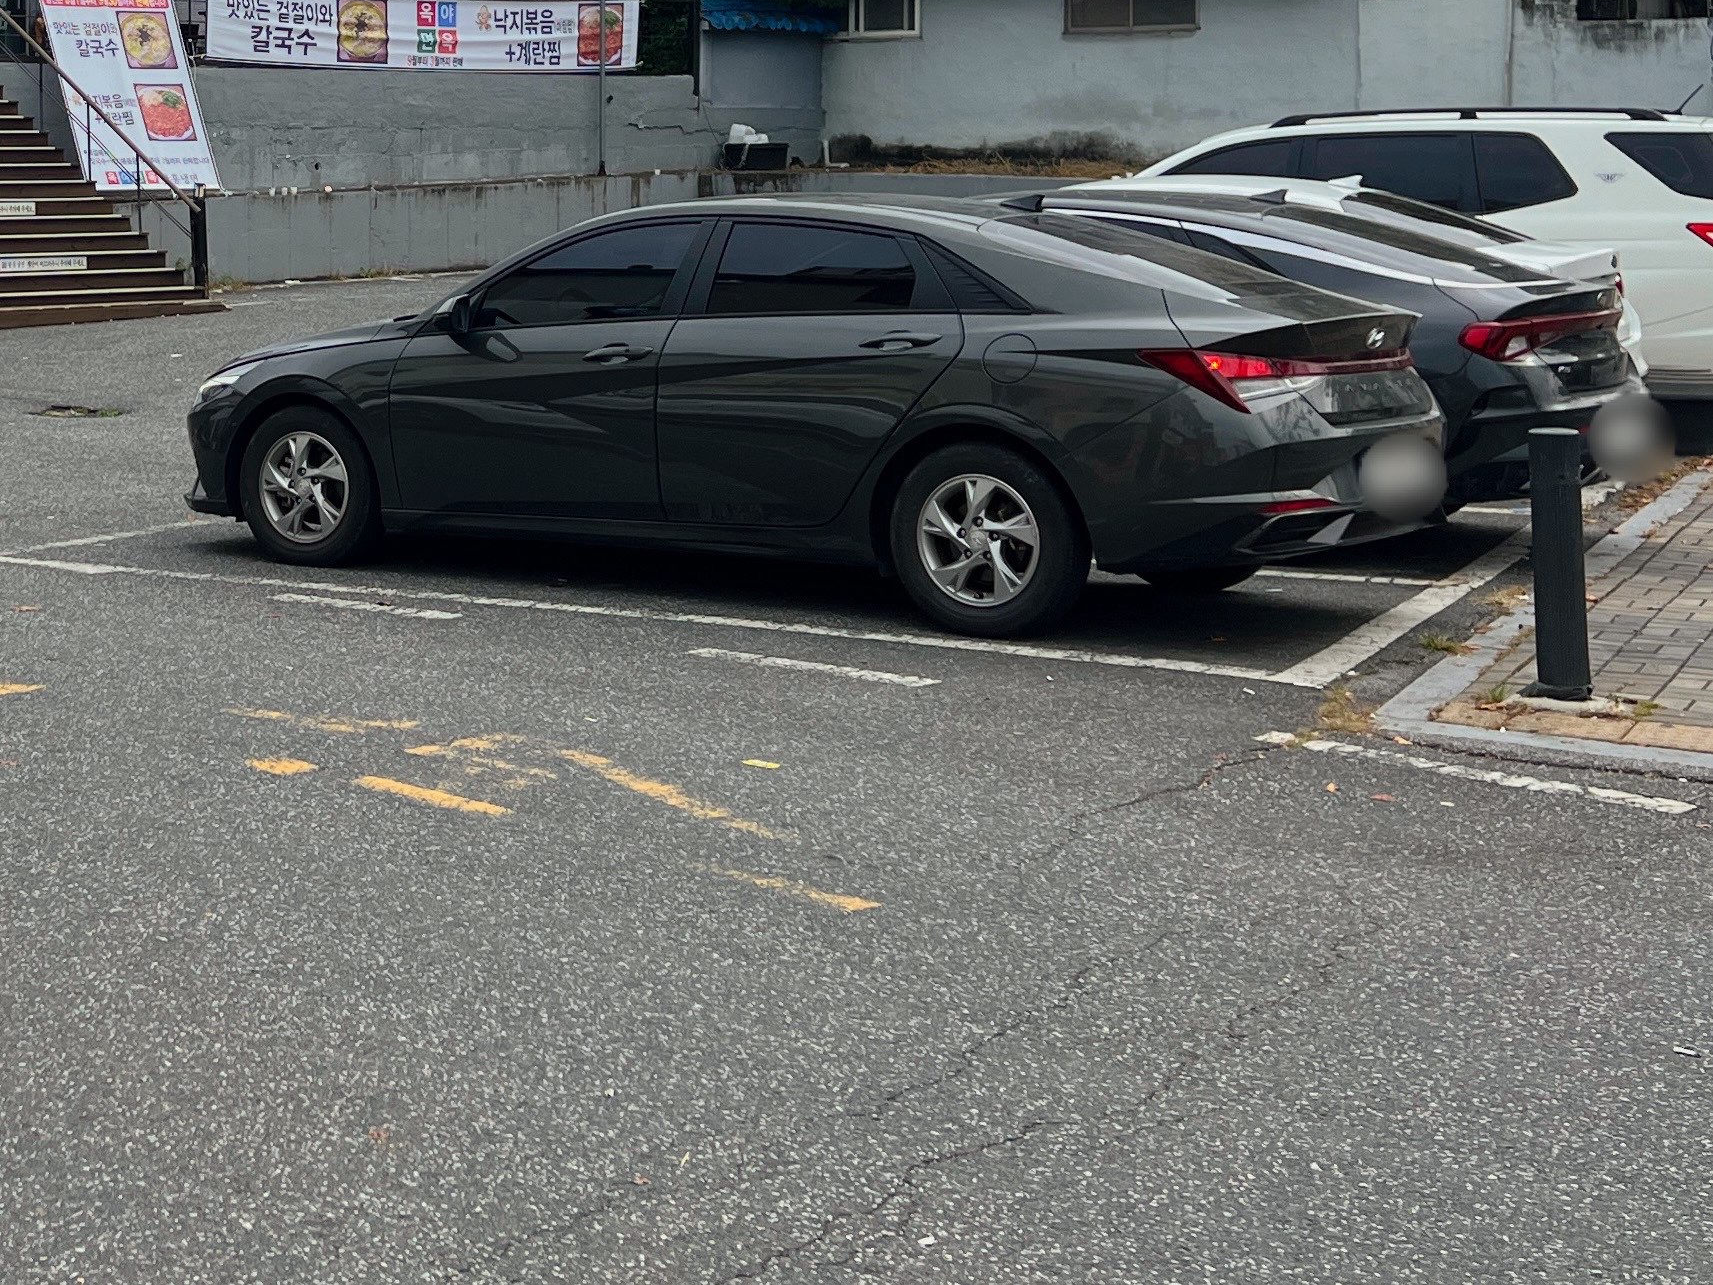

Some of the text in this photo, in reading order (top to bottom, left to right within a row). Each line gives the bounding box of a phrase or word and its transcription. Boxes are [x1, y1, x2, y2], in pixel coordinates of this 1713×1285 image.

[277, 0, 334, 27] 겉절이와
[419, 2, 456, 24] 옥야
[493, 8, 554, 35] 낙지볶음
[53, 21, 81, 36] 맛있는
[251, 24, 318, 56] 칼국수
[76, 38, 119, 58] 칼국수
[504, 39, 562, 66] +계란찜
